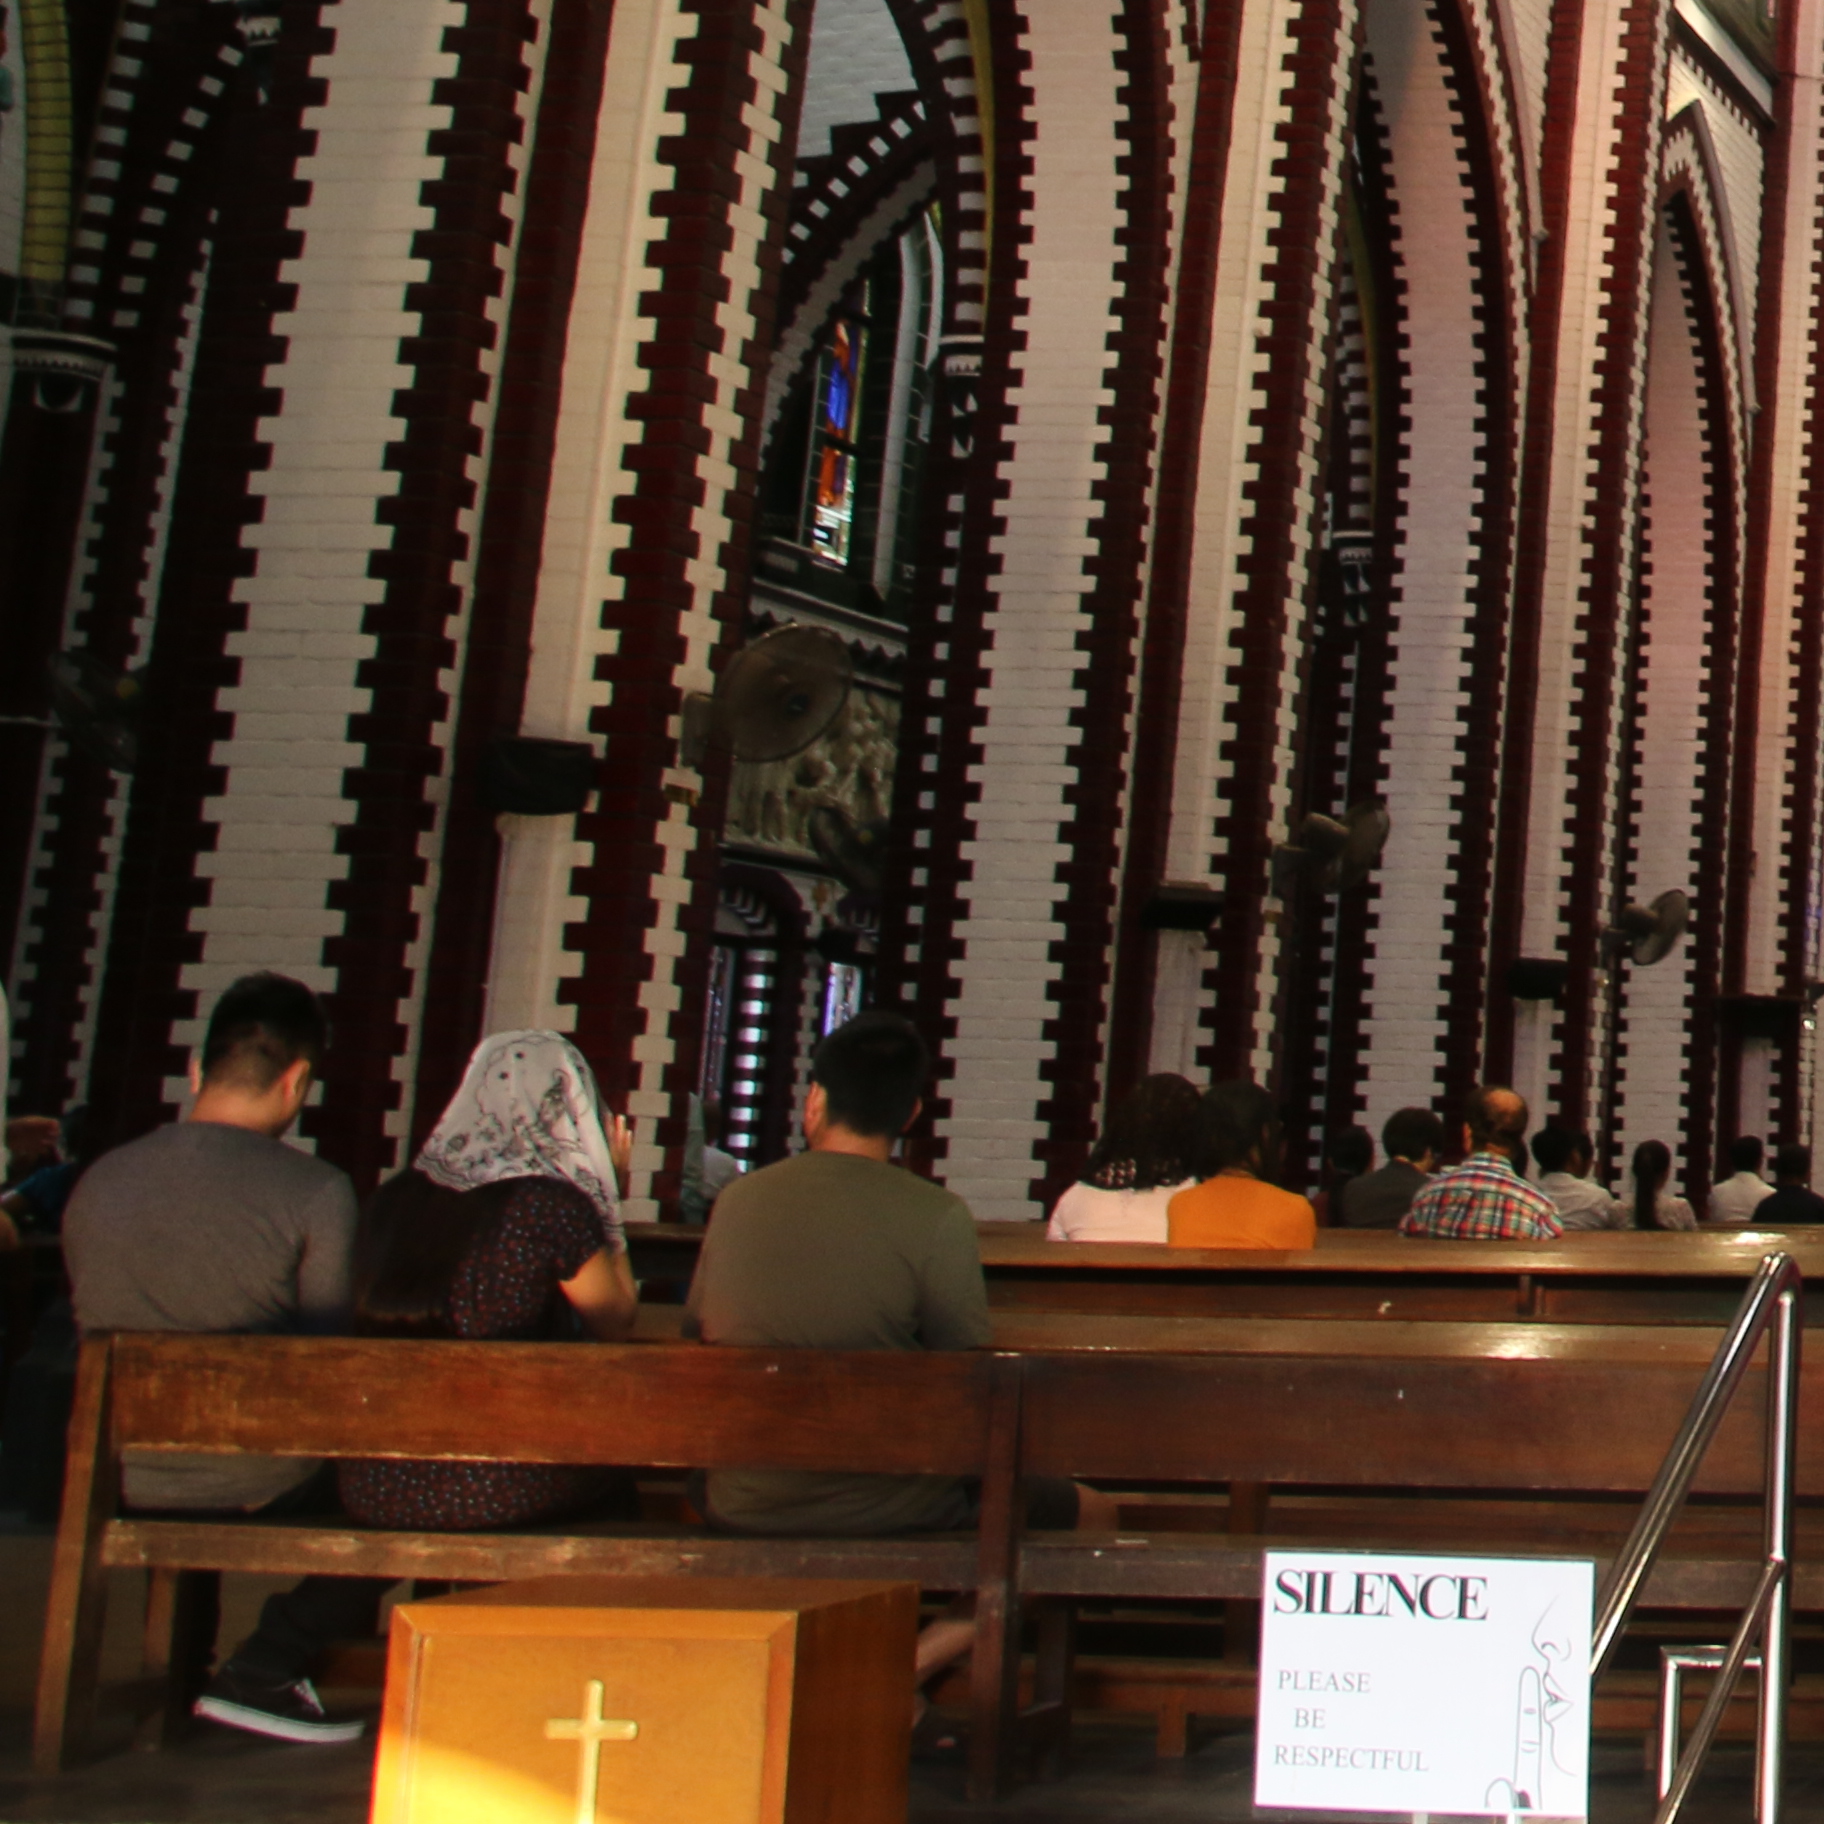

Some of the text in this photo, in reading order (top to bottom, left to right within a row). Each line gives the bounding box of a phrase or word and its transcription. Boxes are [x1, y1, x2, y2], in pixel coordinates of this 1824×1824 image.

[1273, 1568, 1489, 1621] SILENCE
[1277, 1670, 1371, 1693] PLEASE
[1294, 1708, 1326, 1729] BE
[1273, 1744, 1429, 1772] RESPECTFUL
